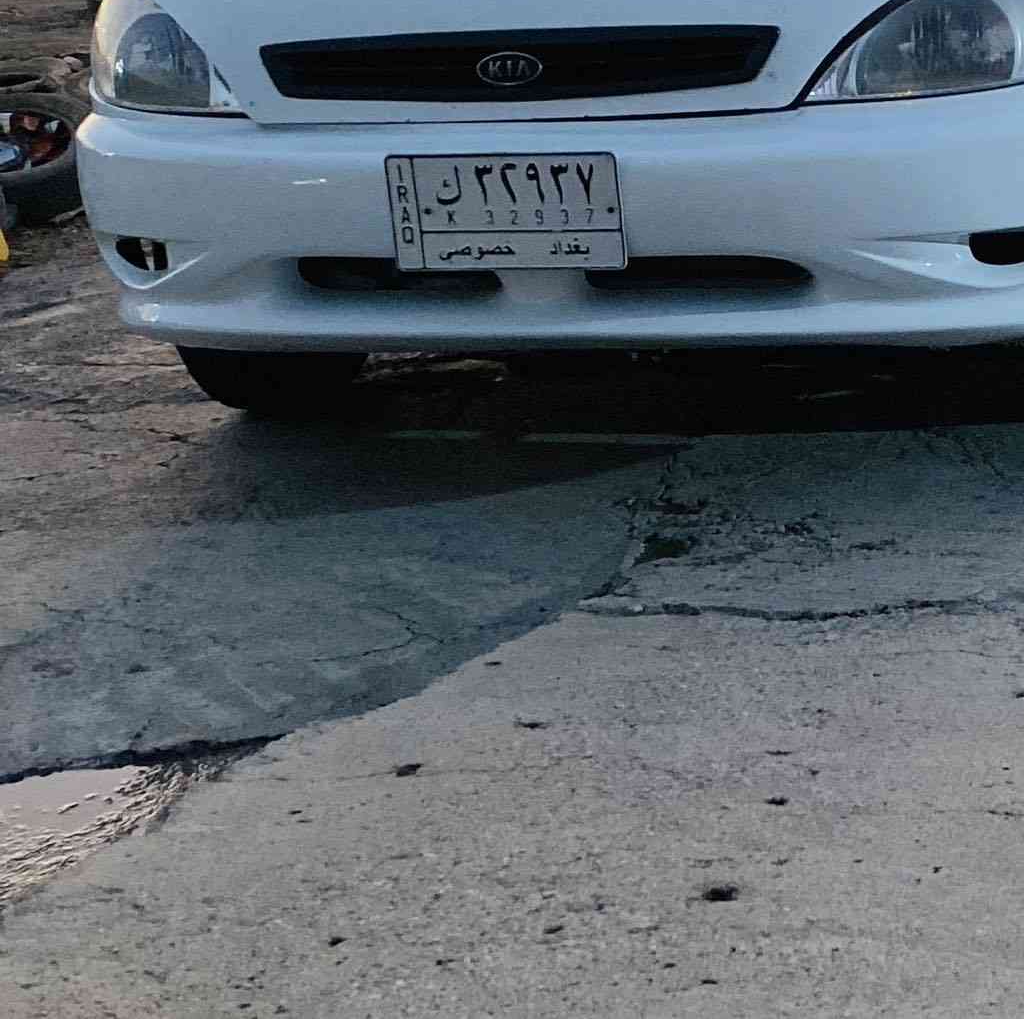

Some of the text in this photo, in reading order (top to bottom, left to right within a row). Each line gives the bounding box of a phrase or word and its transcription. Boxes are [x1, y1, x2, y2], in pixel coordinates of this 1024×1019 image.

[488, 60, 532, 77] KIA
[396, 164, 414, 244] IRAQ
[446, 208, 594, 225] K 32937
[550, 237, 590, 260] بغداد
